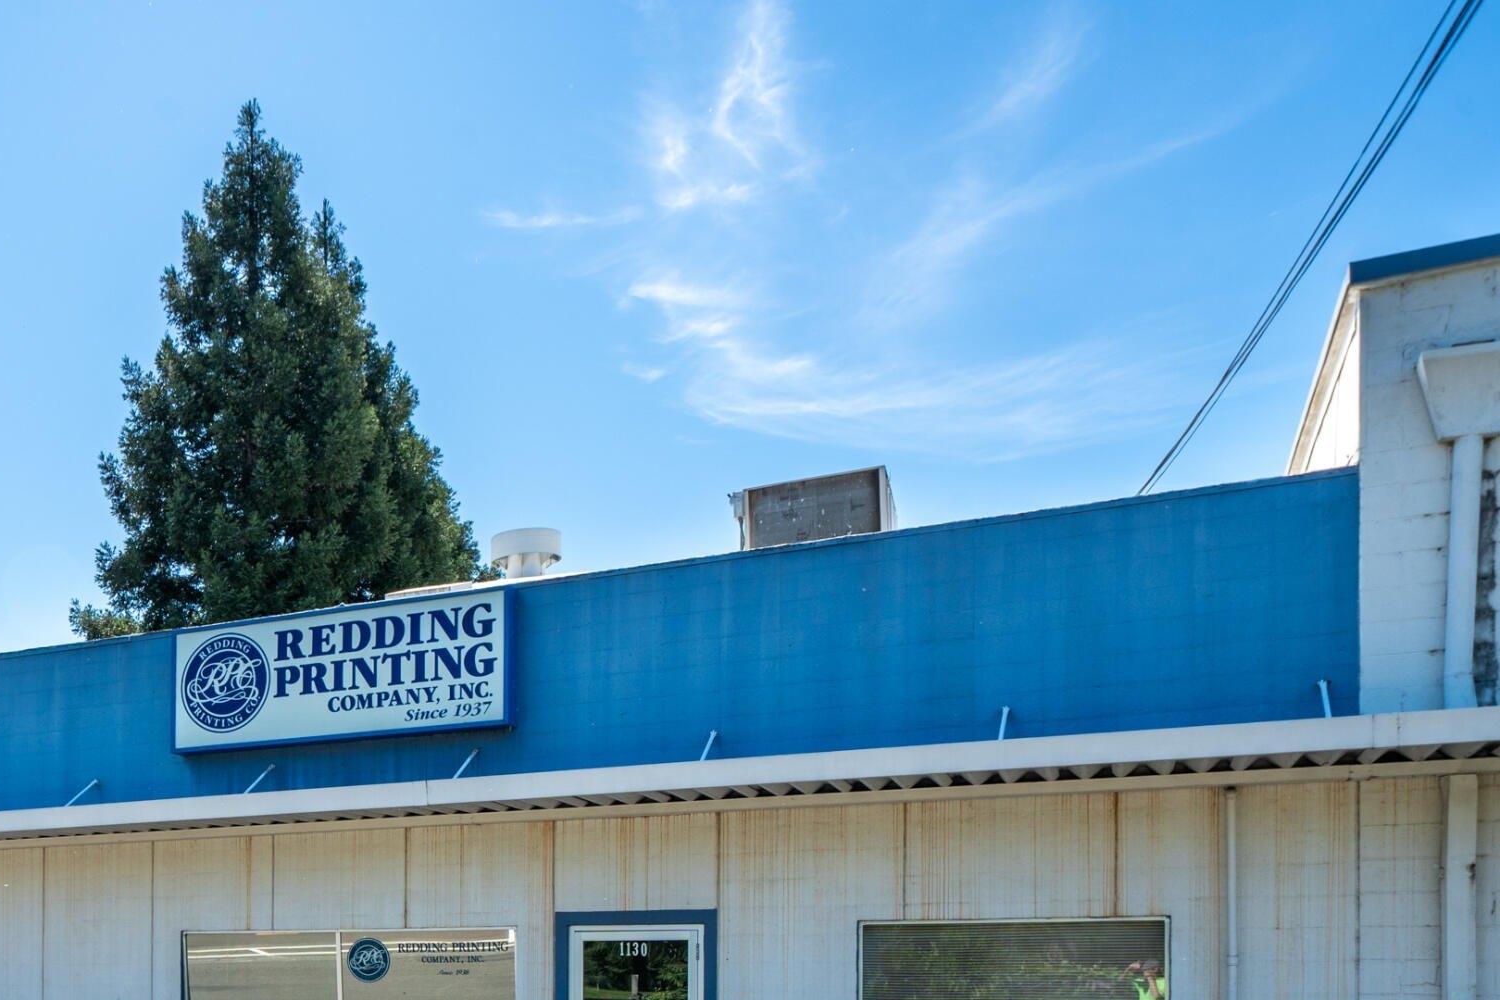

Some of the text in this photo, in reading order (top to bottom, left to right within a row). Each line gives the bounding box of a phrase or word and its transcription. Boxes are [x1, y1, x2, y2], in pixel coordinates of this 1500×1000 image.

[274, 603, 497, 662] REDDING
[198, 639, 252, 660] REDDING
[273, 642, 498, 698] PRINTING
[327, 681, 493, 713] COMPANY, INC.
[189, 696, 261, 727] PRINTING CO.
[404, 701, 492, 722] Since 1937
[397, 941, 509, 953] REDDING PRINTING
[619, 942, 648, 957] 1130
[421, 955, 485, 964] COMPANY, INC.
